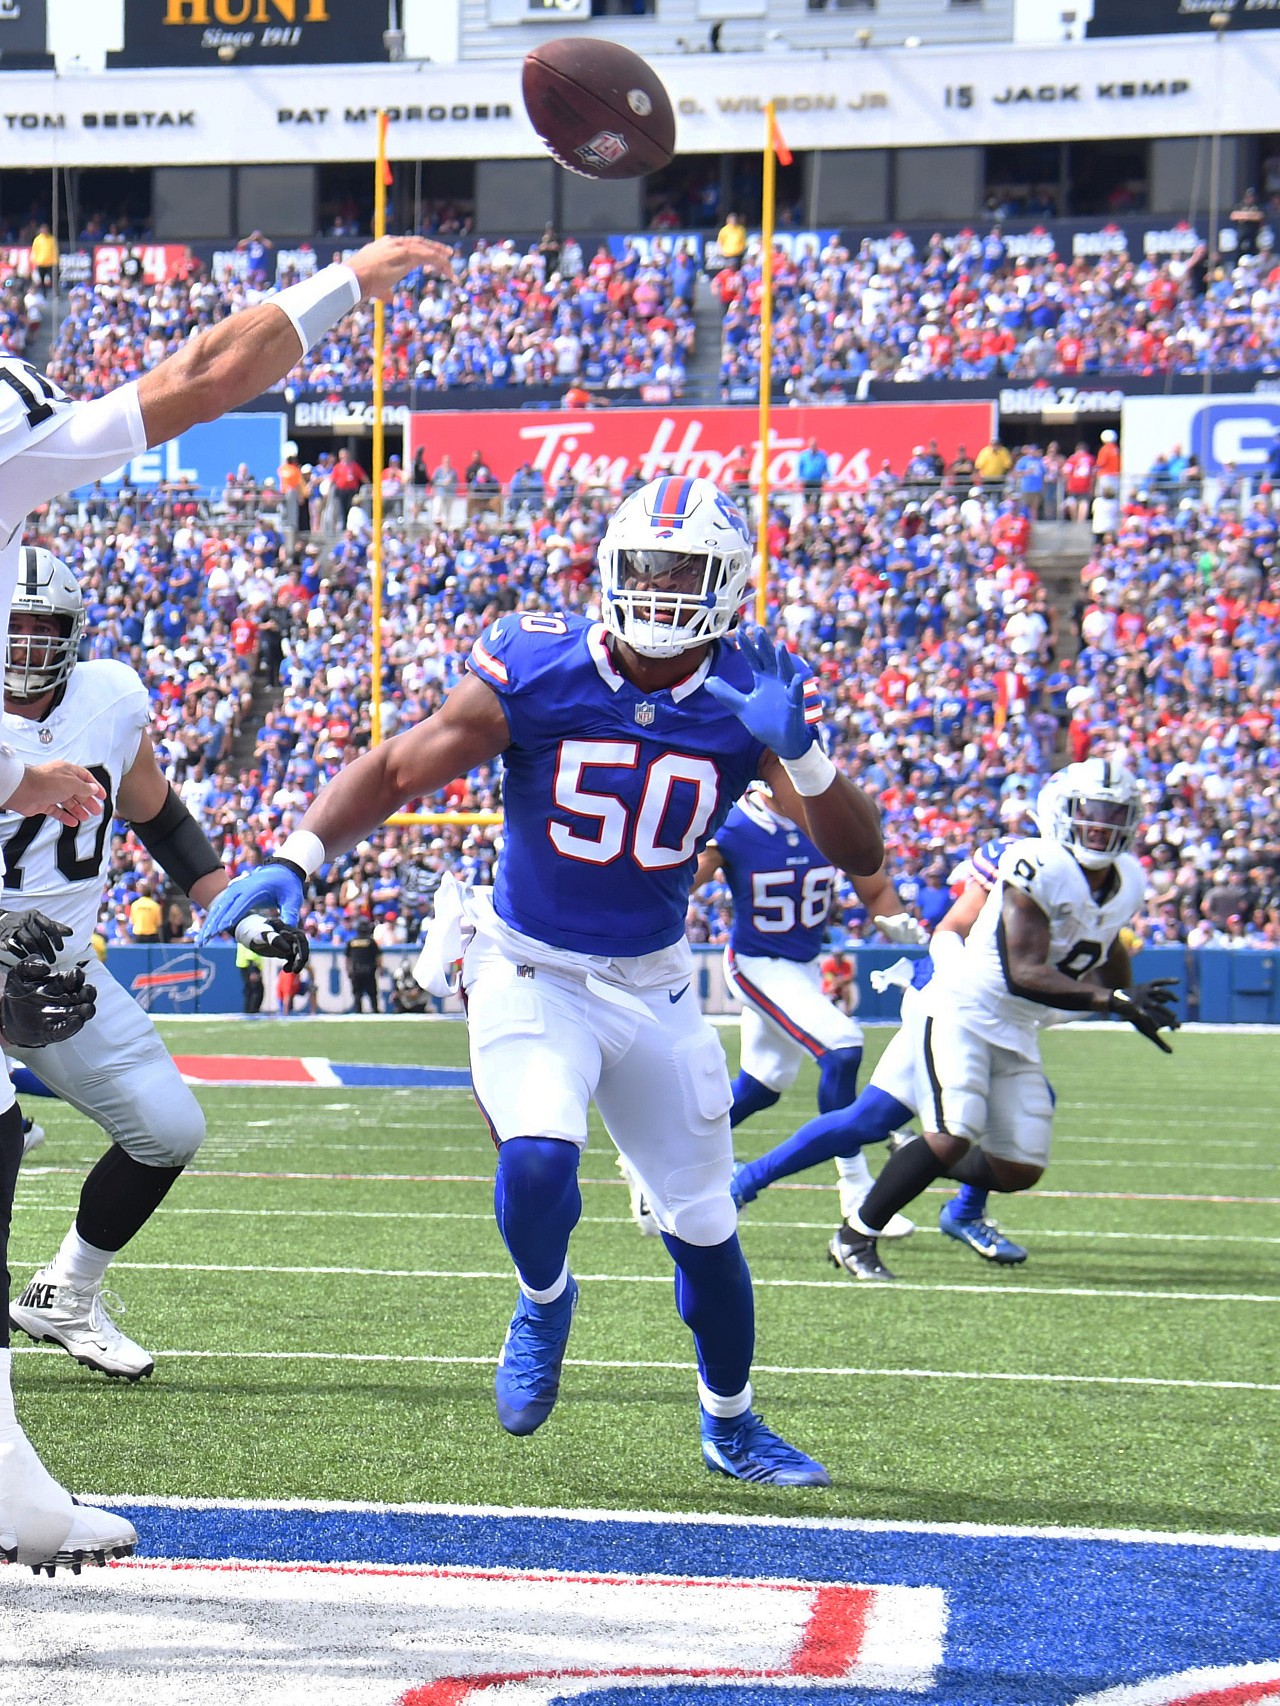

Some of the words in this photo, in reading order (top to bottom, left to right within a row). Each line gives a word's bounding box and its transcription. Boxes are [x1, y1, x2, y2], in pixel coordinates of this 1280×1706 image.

[201, 28, 255, 48] Since
[261, 26, 302, 46] 1911
[945, 84, 974, 108] 15
[992, 83, 1081, 104] JACK
[1097, 79, 1191, 99] KEMP
[4, 113, 66, 130] TOM
[277, 108, 329, 124] PAT
[519, 422, 630, 490] Tim
[547, 739, 720, 871] 50
[751, 865, 837, 934] 58
